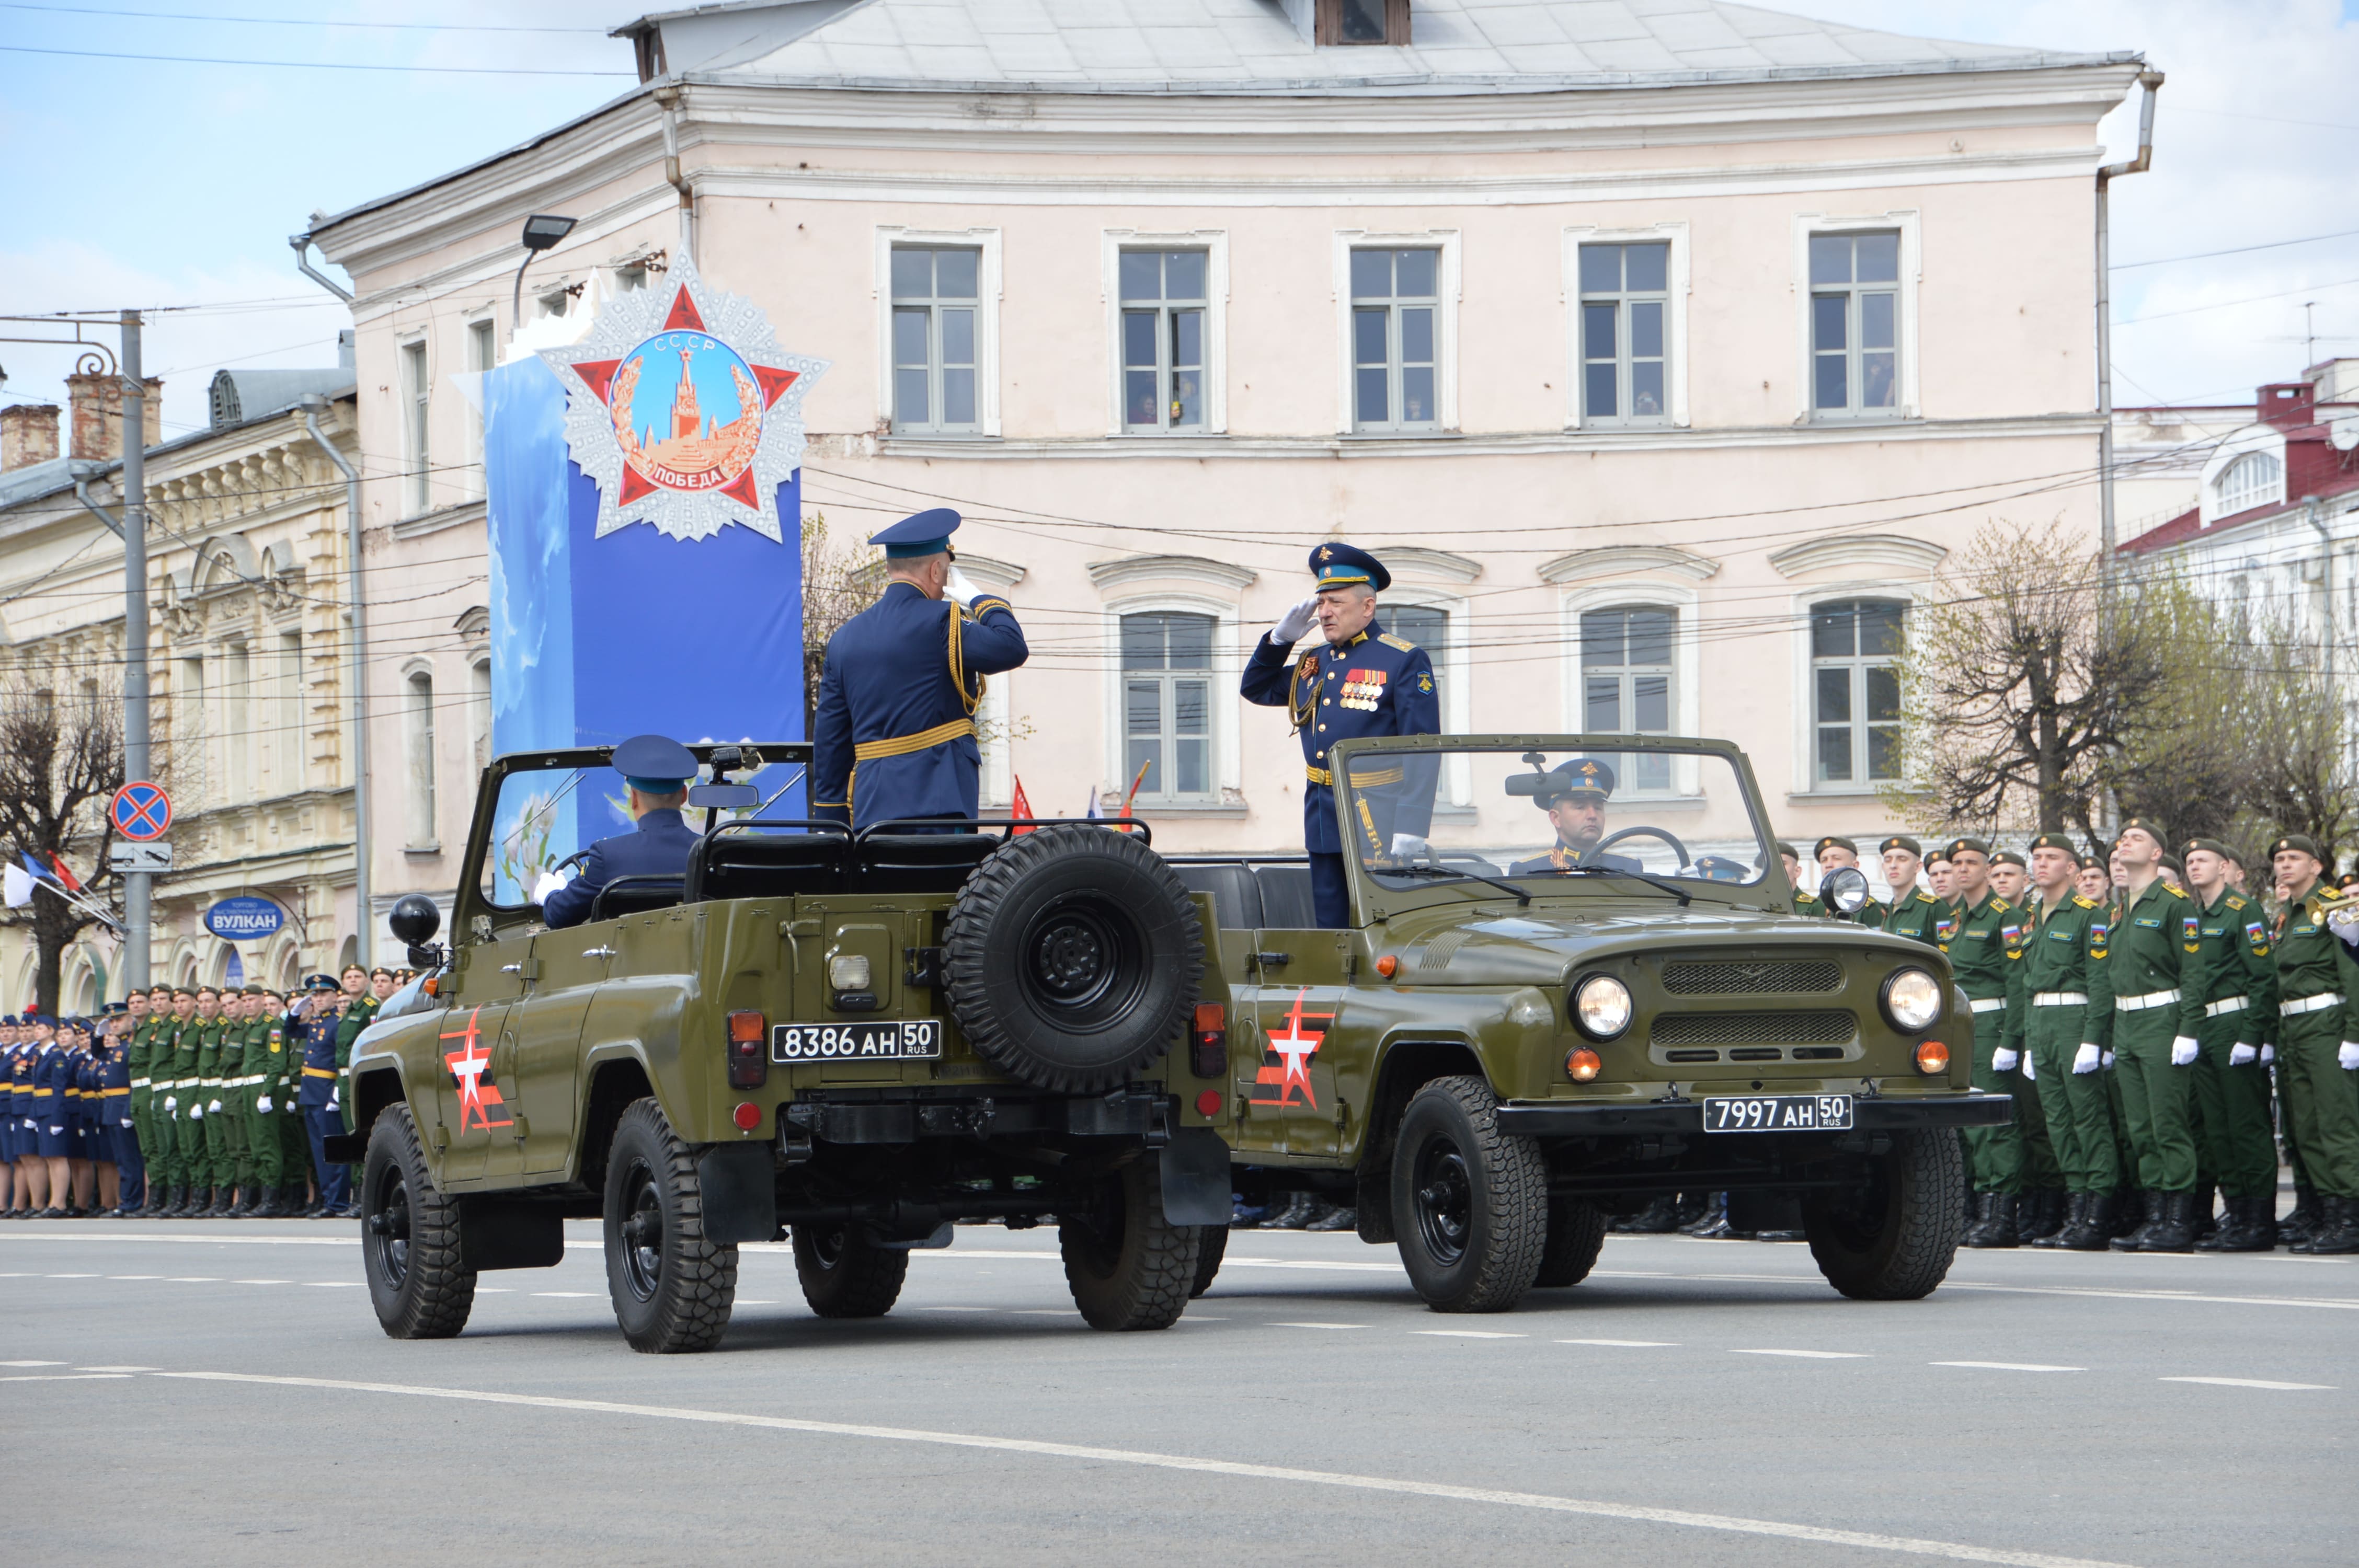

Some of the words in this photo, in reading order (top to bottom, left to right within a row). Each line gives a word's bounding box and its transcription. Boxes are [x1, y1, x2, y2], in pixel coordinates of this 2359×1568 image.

[655, 335, 716, 351] СССР
[655, 467, 722, 488] ПОБЕДА
[213, 915, 277, 928] ВУЛКАН
[785, 1028, 855, 1057] 8386
[861, 1032, 895, 1054] АН
[904, 1024, 931, 1046] 50
[907, 1046, 927, 1054] RUS
[1715, 1100, 1778, 1127] 7997
[1783, 1105, 1813, 1126] АН
[1820, 1098, 1844, 1118] 50
